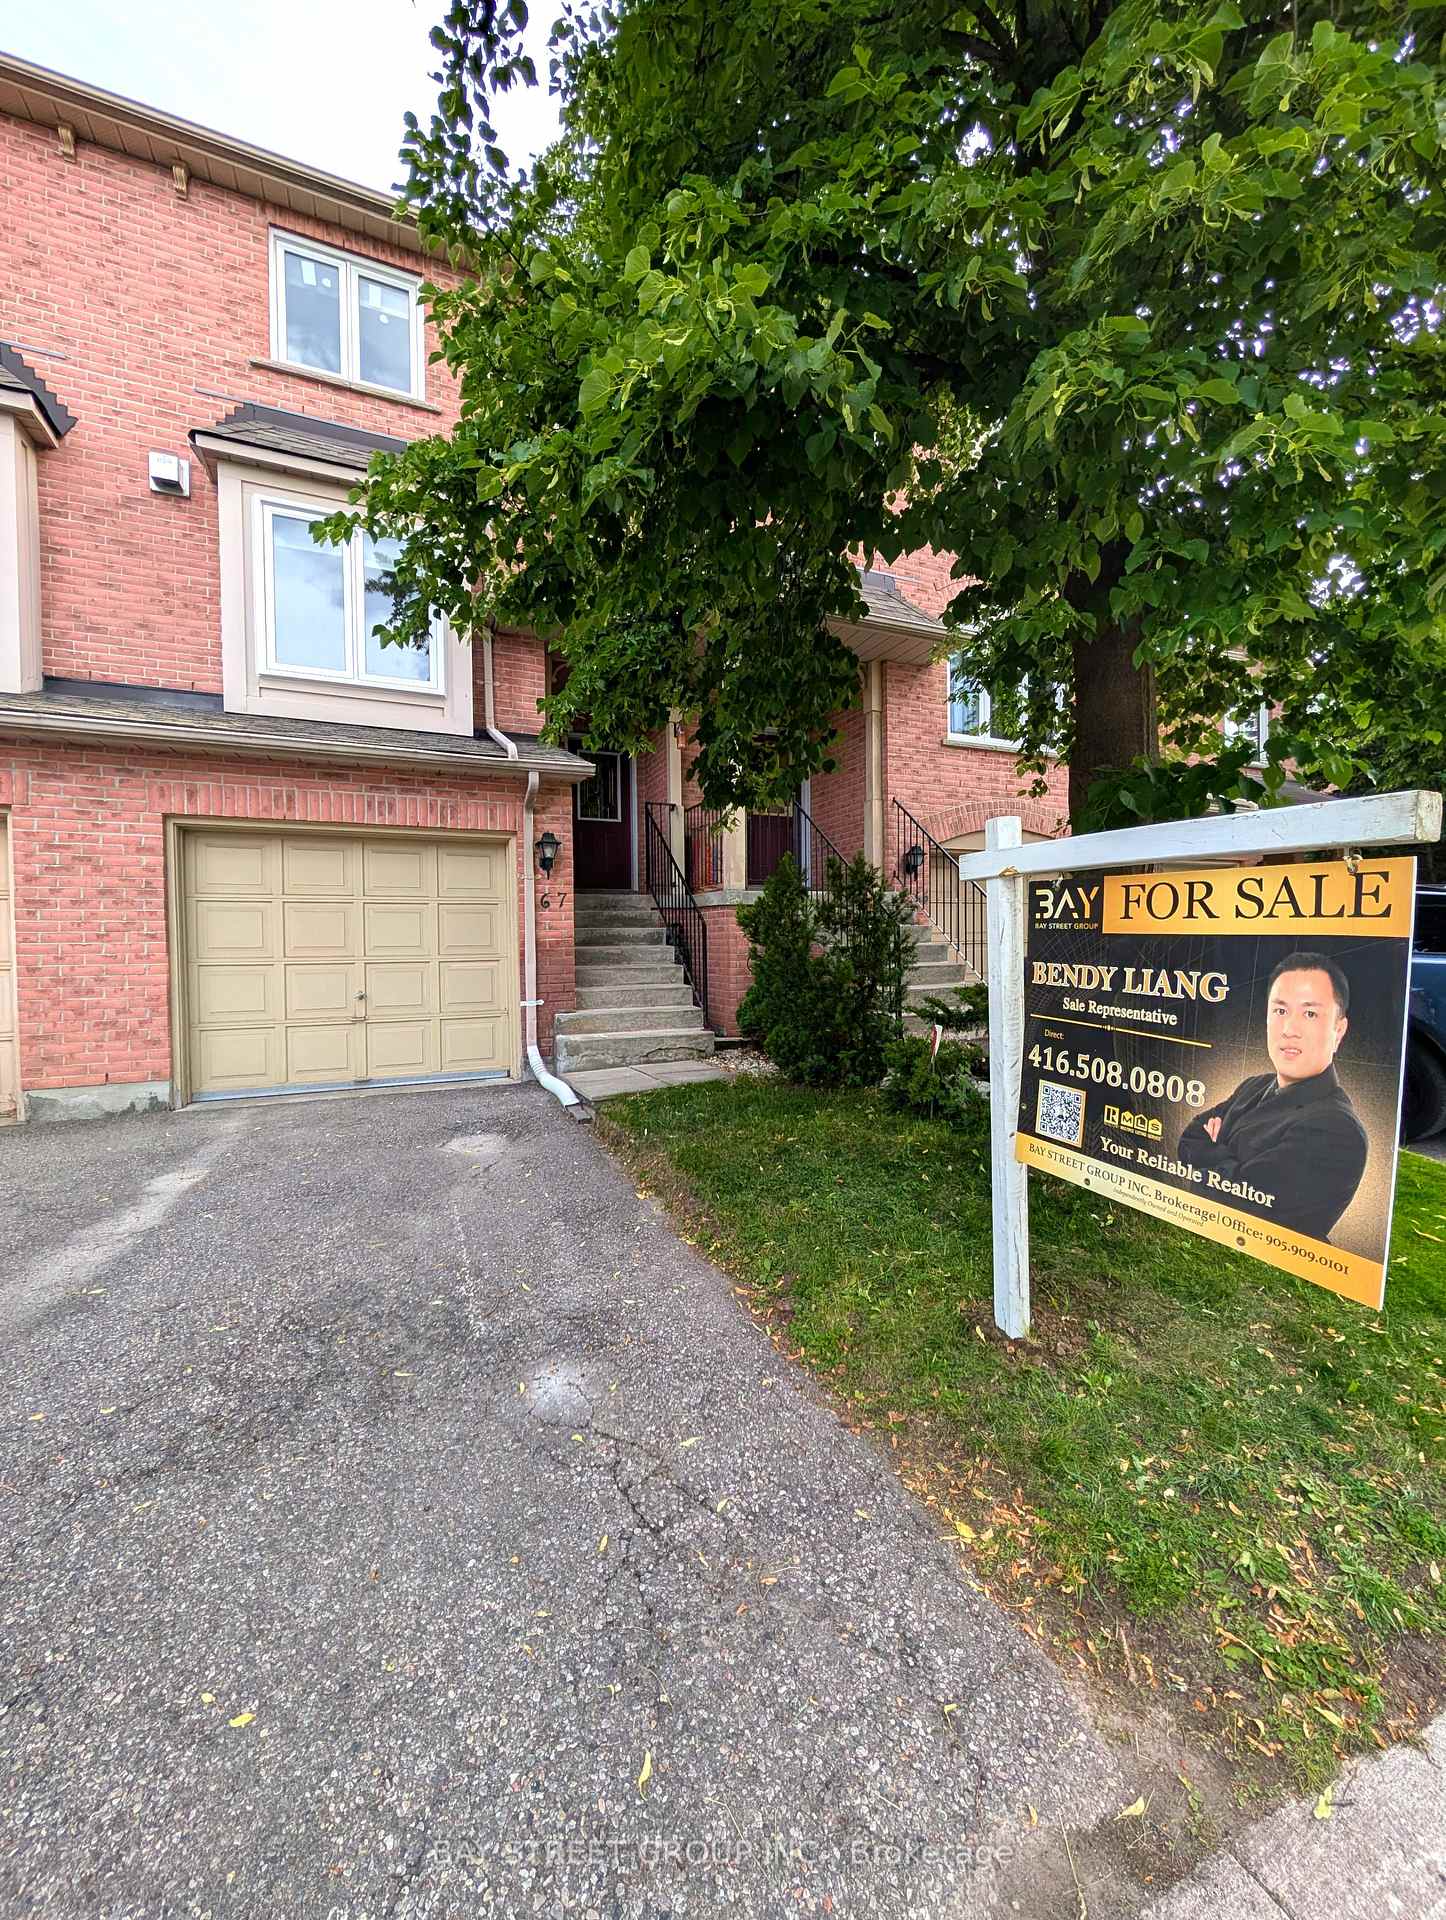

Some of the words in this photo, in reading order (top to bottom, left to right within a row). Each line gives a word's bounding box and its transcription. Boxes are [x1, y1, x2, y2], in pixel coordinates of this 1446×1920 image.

[540, 892, 567, 909] 67
[1035, 887, 1100, 919] BAY
[1119, 881, 1220, 920] FOR
[1235, 871, 1392, 919] SALE
[1034, 922, 1048, 930] BAY
[1048, 922, 1073, 930] STREET
[1073, 922, 1099, 930] GROUP
[1032, 961, 1119, 993] BENDY
[1123, 967, 1230, 1003] LIANG
[1062, 997, 1086, 1012] Sale
[1087, 1000, 1178, 1026] Representative
[1044, 1028, 1065, 1040] Direct:
[1028, 1044, 1206, 1107] 416.508.0808
[1100, 1135, 1134, 1160] Your
[1136, 1147, 1203, 1183] Reliable
[1206, 1170, 1276, 1208] Realtor
[1028, 1143, 1048, 1157] BAY
[1047, 1150, 1085, 1171] STREET
[1086, 1163, 1126, 1186] GROUP
[1127, 1179, 1152, 1198] INC.
[1265, 1234, 1350, 1275] 905.909.0101
